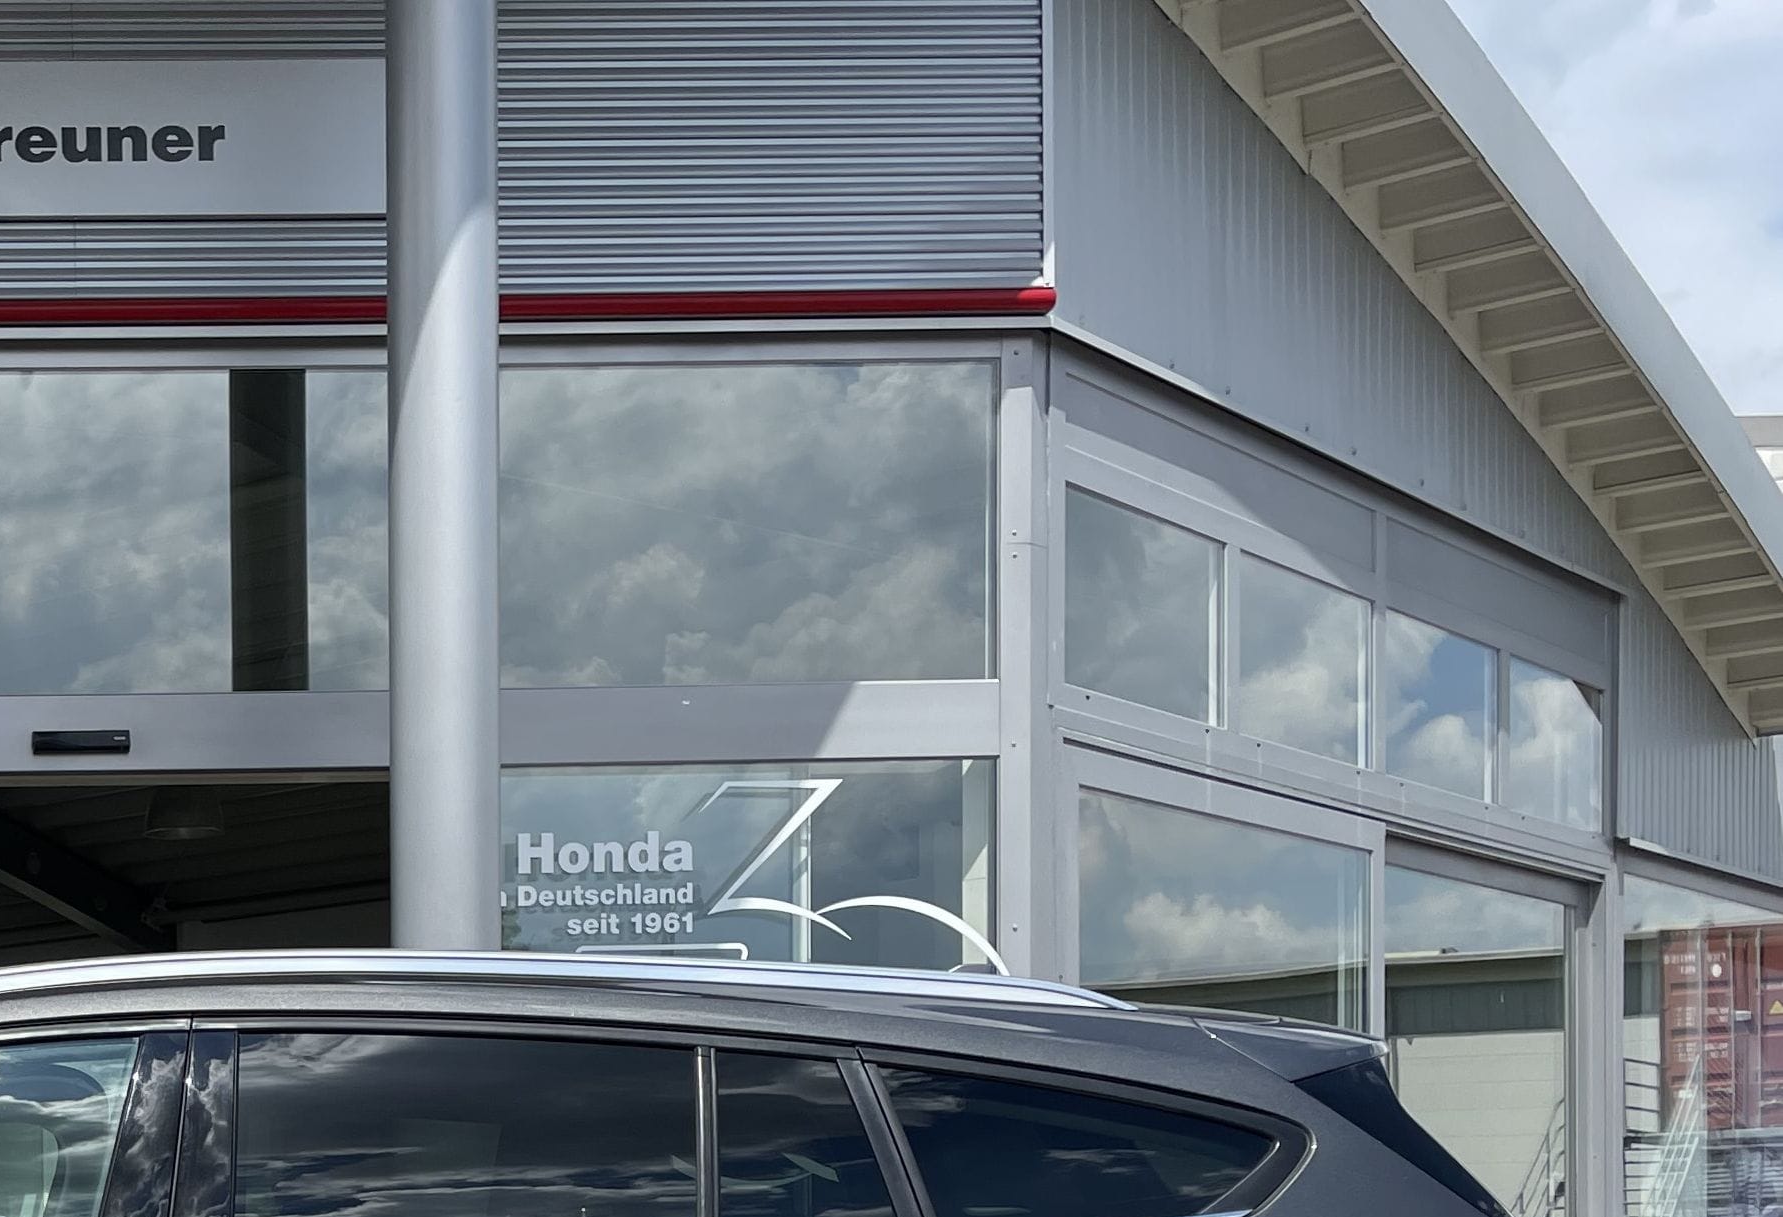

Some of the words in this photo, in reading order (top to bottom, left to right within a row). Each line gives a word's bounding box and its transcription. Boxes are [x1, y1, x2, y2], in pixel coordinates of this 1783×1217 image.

[517, 831, 693, 875] Honda
[517, 882, 693, 907] Deutschland
[567, 912, 620, 935] seit
[630, 911, 693, 934] 1961
